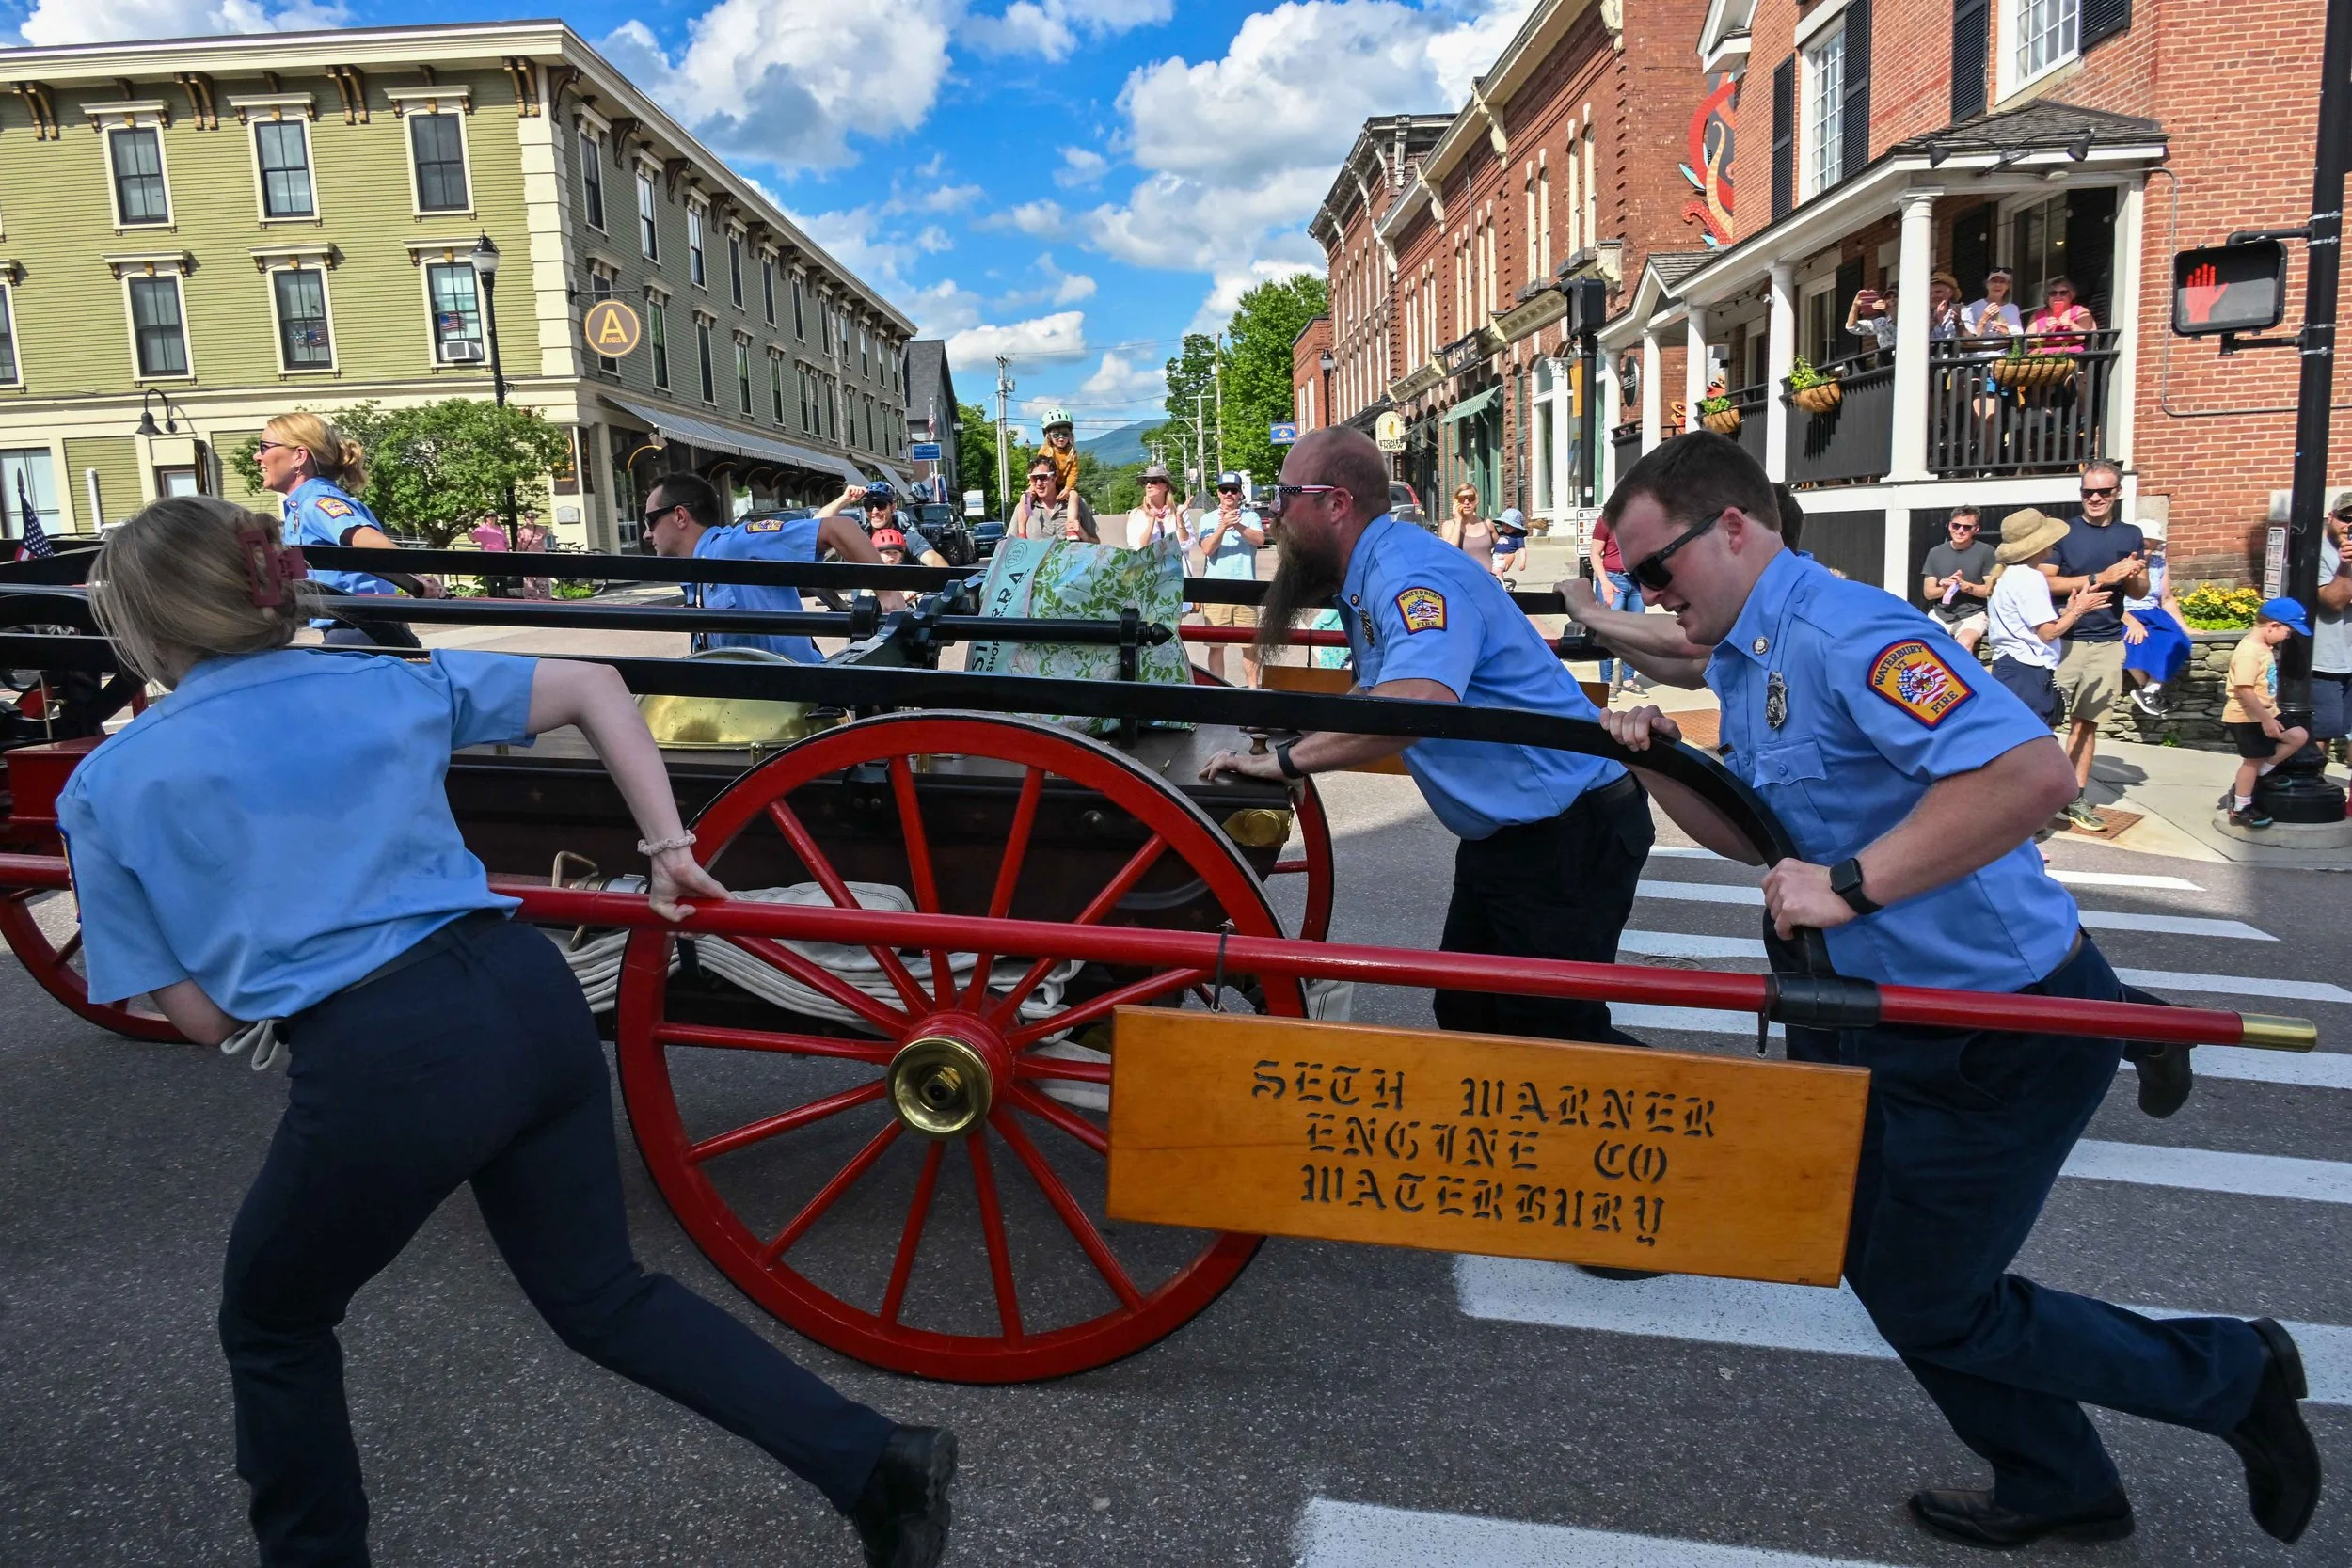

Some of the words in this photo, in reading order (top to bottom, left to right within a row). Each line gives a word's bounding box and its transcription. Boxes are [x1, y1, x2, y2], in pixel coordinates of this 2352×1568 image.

[598, 309, 628, 344] A
[1400, 590, 1442, 601] WATERBURY
[1874, 644, 1924, 686] WATERBURY
[1893, 659, 1908, 672] VT
[1931, 690, 1959, 714] FIRE
[1251, 1059, 1405, 1111] SETH
[1460, 1076, 1715, 1138] WARNER
[1305, 1112, 1540, 1170] ENGINE
[1593, 1139, 1668, 1184] CO
[1300, 1164, 1665, 1246] WATERBURY
